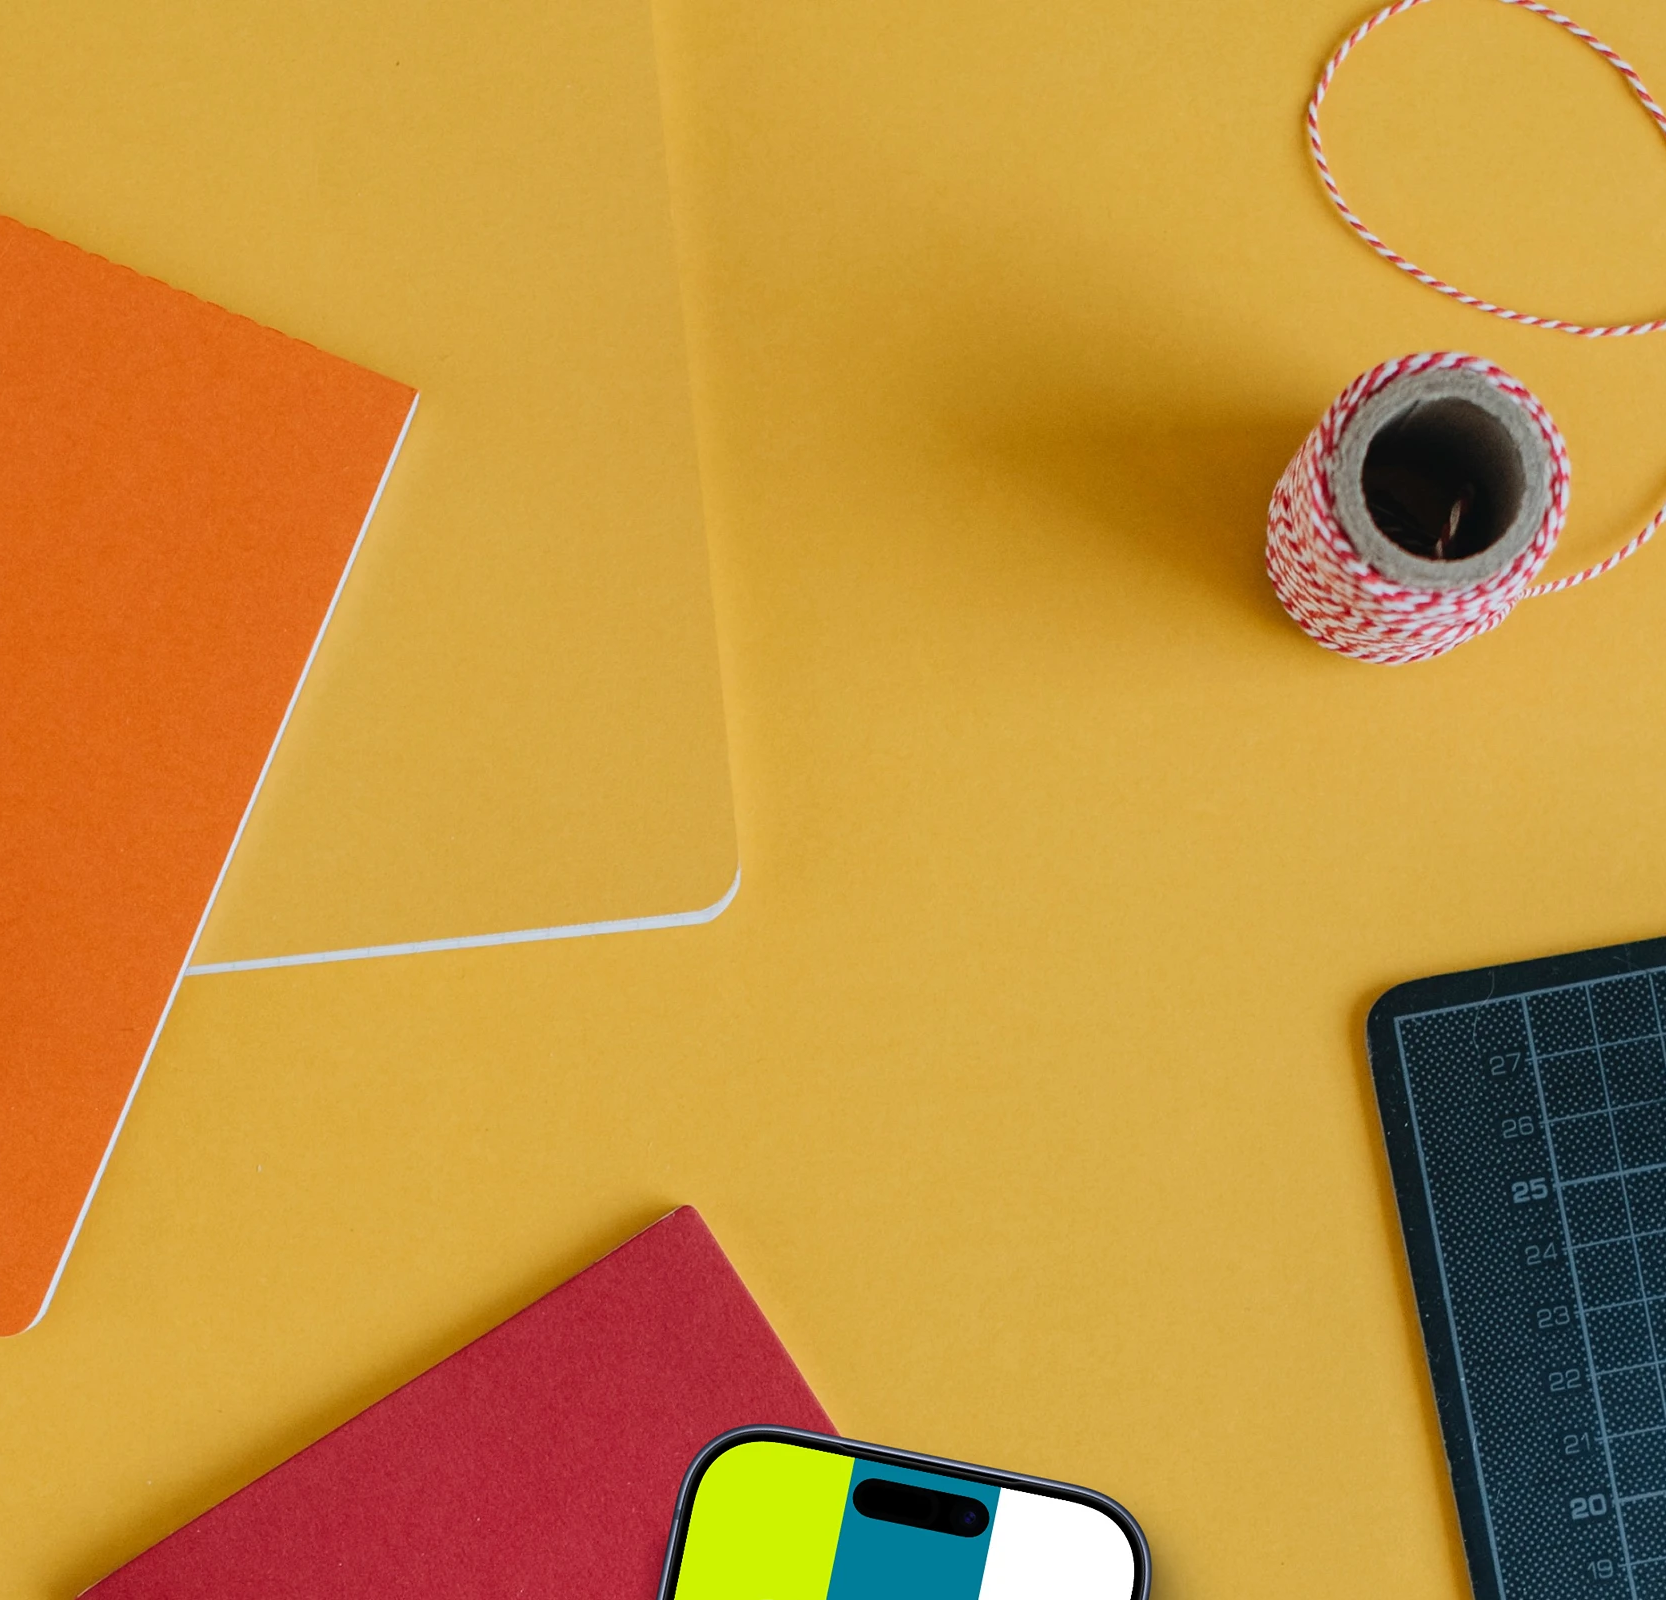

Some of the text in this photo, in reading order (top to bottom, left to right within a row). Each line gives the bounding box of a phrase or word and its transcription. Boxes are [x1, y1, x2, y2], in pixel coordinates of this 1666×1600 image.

[1490, 1053, 1522, 1075] 27
[1502, 1116, 1534, 1139] 26
[1511, 1178, 1548, 1203] 25
[1524, 1243, 1558, 1266] 24
[1536, 1305, 1570, 1328] 23
[1548, 1369, 1582, 1392] 22
[1564, 1432, 1591, 1455] 21
[1571, 1496, 1606, 1520] 20
[1588, 1559, 1614, 1580] 19
